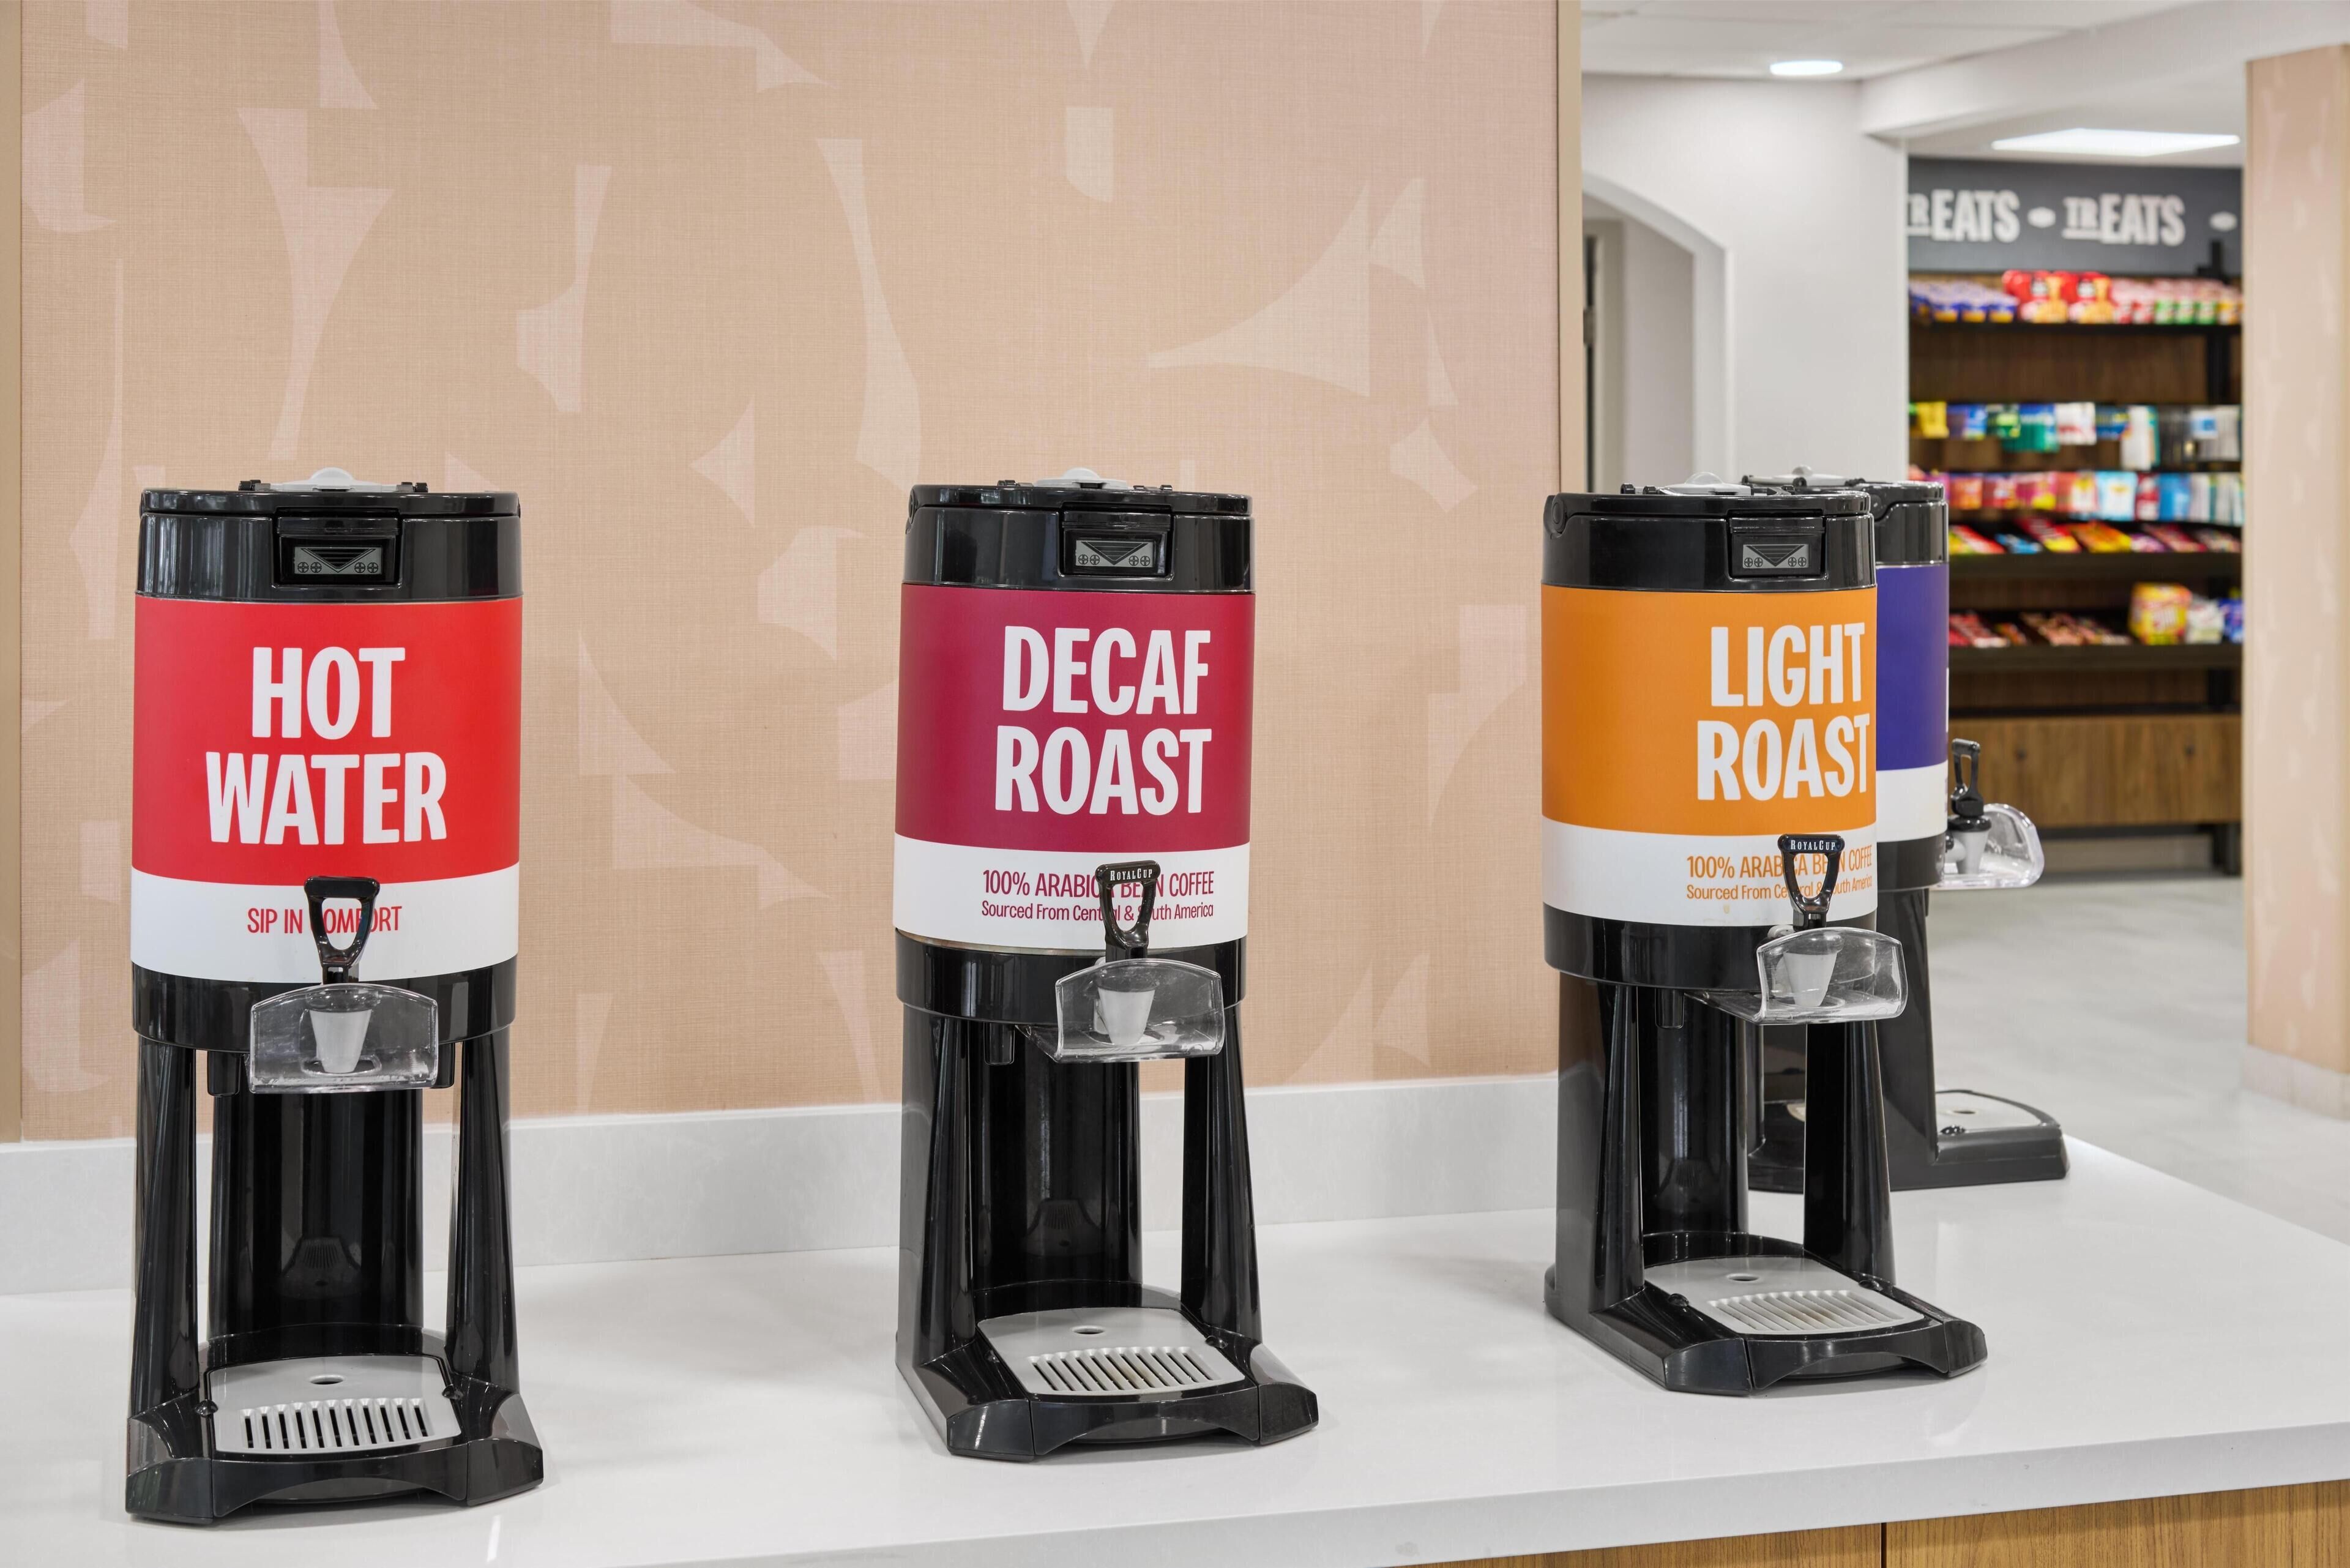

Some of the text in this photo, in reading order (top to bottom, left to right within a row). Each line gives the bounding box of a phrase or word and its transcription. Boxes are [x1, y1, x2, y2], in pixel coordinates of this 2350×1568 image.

[1908, 189, 2020, 242] REATS
[252, 646, 405, 739] HOT
[1003, 625, 1211, 715] DECAF
[1710, 622, 1865, 707] LIGHT
[995, 725, 1212, 816] ROAST
[1697, 713, 1870, 802] ROAST
[206, 752, 447, 845] WATER
[983, 870, 1030, 895] 100%
[1035, 873, 1114, 898] ARABIC
[1121, 874, 1164, 898] BEN
[1169, 871, 1214, 897] COFFEE
[1687, 845, 1872, 878] 100% ARABA BEN COFFEE
[1687, 884, 1738, 900] Sourced
[1742, 885, 1772, 900] From
[1852, 874, 1872, 892] America
[247, 908, 278, 933] SIP
[284, 909, 303, 934] IN
[982, 900, 1033, 919] Sourced
[1037, 904, 1070, 920] From
[1124, 905, 1135, 921] &
[1138, 904, 1171, 920] uth
[1174, 902, 1214, 919] America
